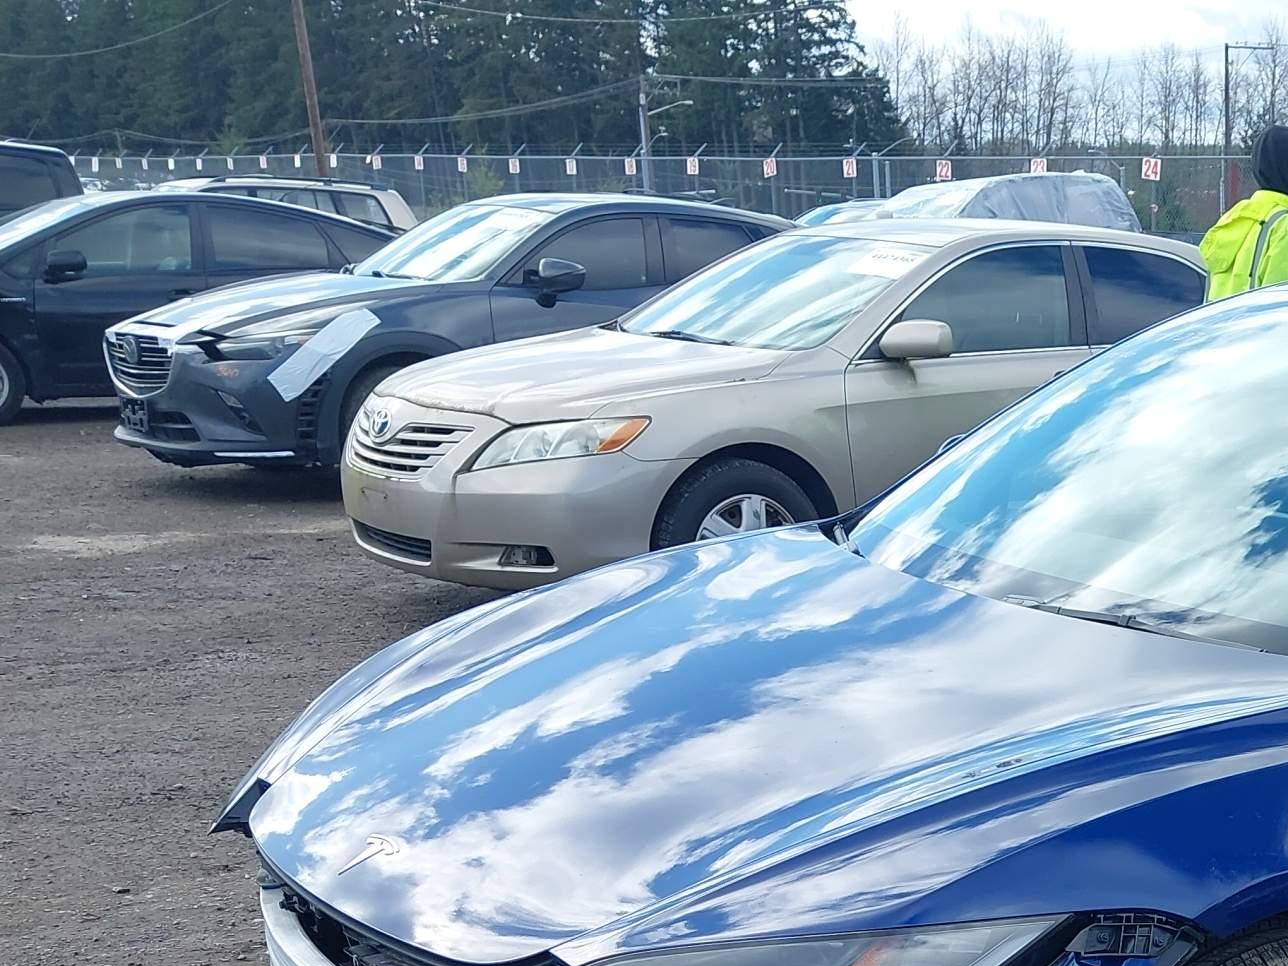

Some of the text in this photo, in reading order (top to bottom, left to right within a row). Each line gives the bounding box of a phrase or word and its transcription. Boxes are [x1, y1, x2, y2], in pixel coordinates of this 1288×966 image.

[764, 159, 775, 175] 20
[845, 160, 855, 176] 21
[938, 161, 950, 178] 22
[1032, 159, 1045, 174] 23
[1143, 159, 1159, 178] 24
